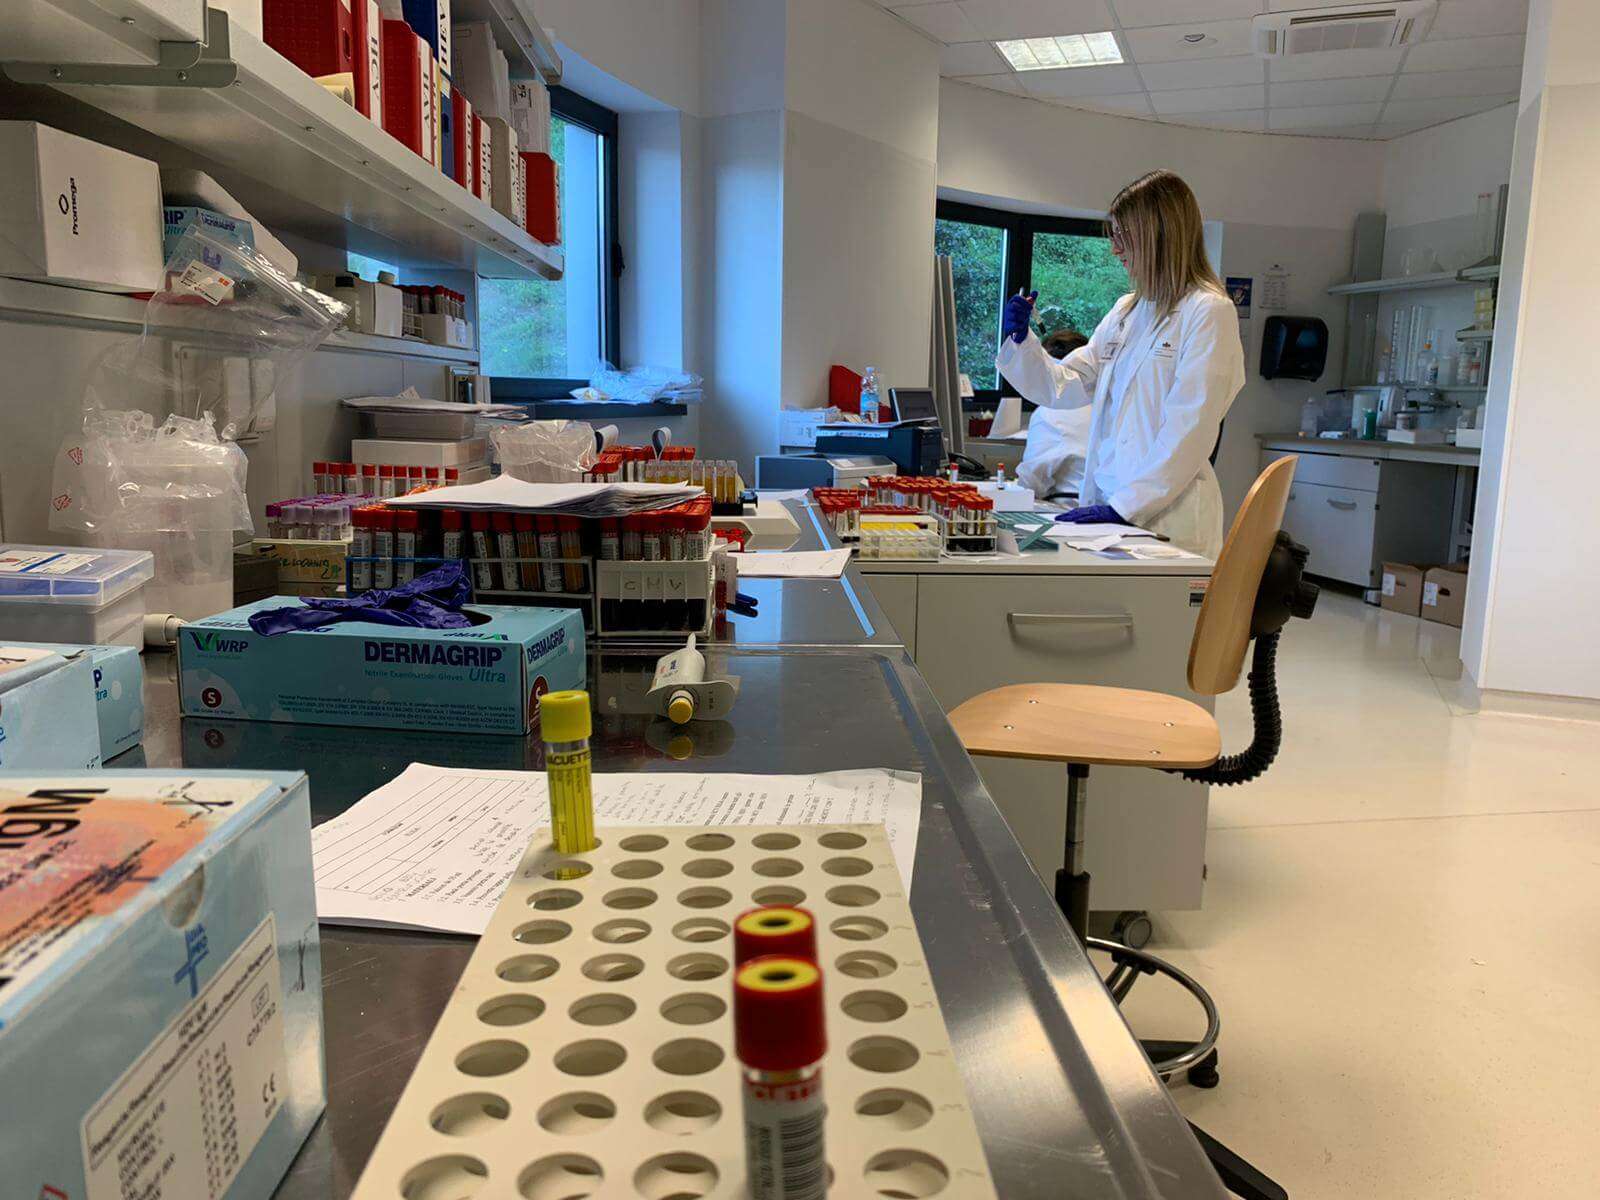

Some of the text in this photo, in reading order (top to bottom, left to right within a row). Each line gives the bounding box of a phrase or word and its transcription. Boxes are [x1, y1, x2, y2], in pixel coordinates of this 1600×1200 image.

[370, 36, 380, 99] HCV
[422, 72, 431, 128] HAV
[70, 177, 79, 235] Promega
[216, 639, 249, 653] WRP
[363, 641, 503, 668] DERMAGRIP
[526, 627, 567, 665] DERMAGRIP
[468, 667, 507, 683] Ultra
[206, 691, 217, 705] S
